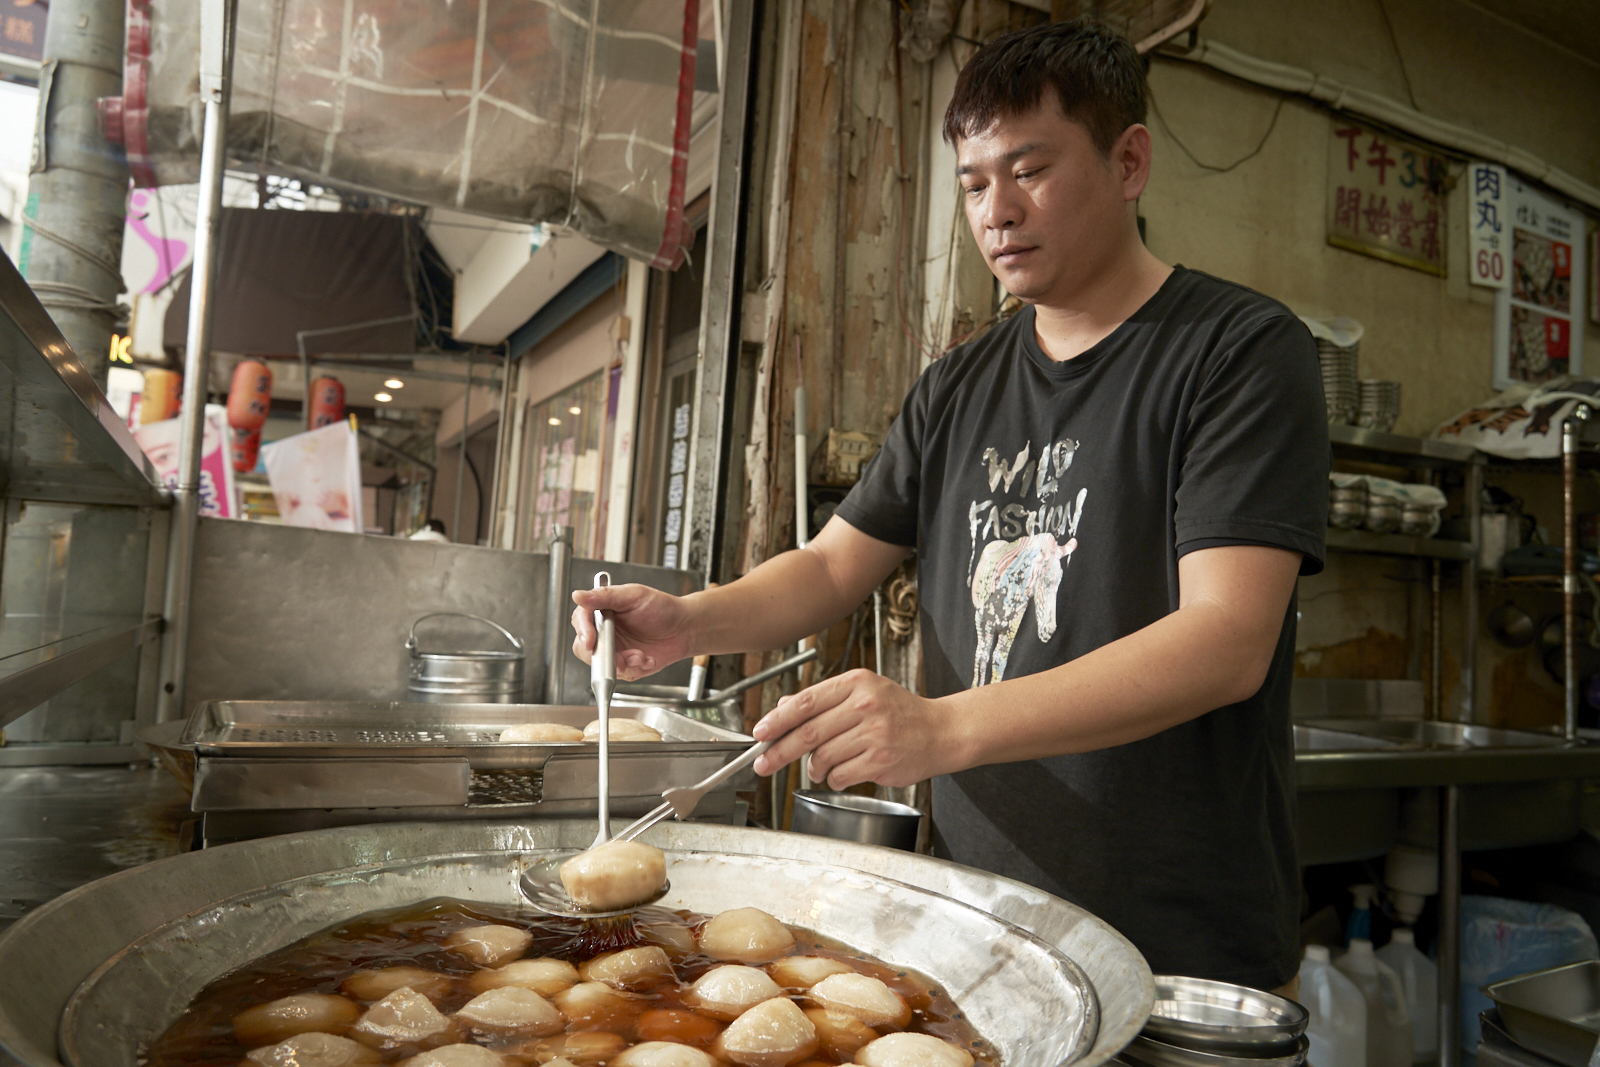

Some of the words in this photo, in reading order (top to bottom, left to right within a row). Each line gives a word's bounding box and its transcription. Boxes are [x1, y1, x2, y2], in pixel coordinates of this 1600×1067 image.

[1475, 167, 1502, 233] 肉丸
[1476, 249, 1503, 281] 60
[981, 438, 1080, 502] WILD
[968, 488, 1088, 542] FASHION
